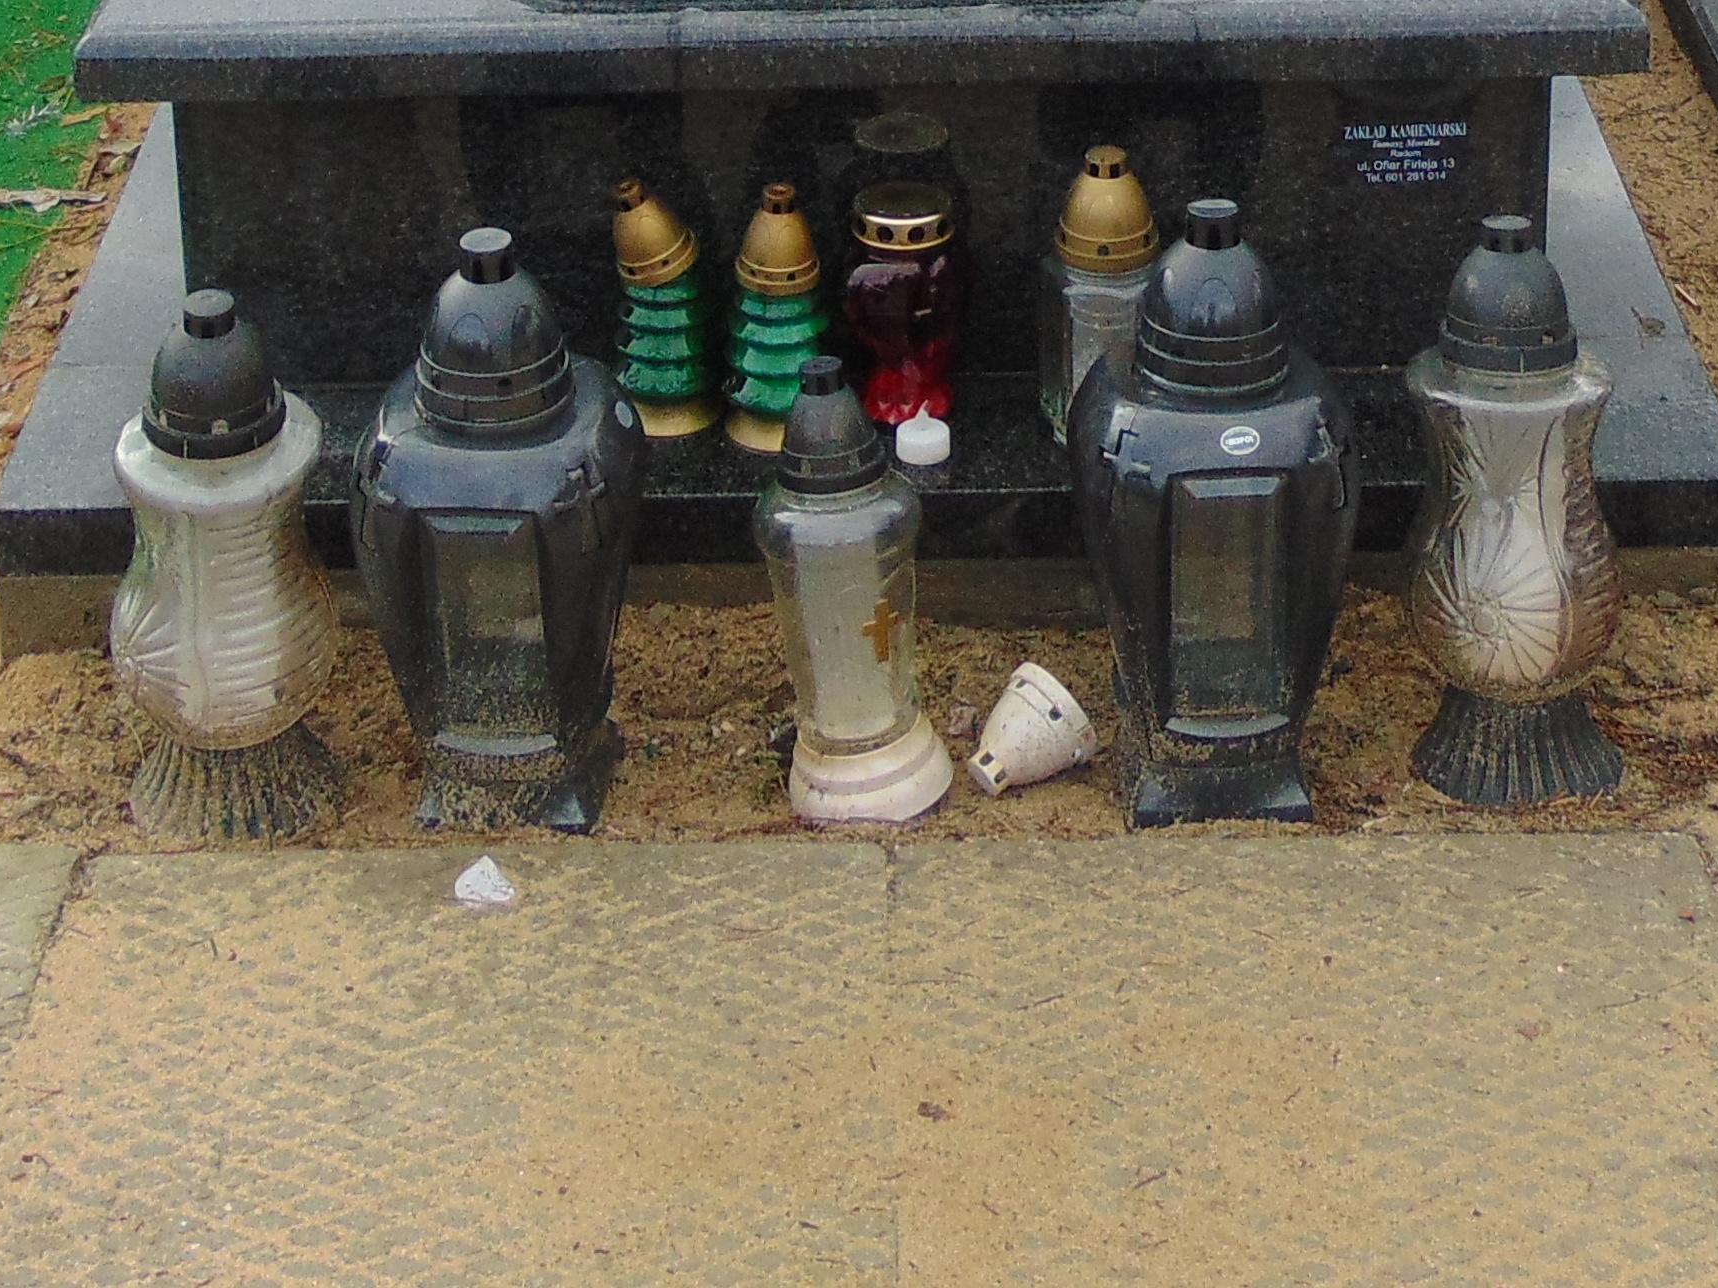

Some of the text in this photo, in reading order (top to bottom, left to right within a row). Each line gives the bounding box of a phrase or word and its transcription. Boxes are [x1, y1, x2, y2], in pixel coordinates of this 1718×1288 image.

[1390, 122, 1468, 138] KAMIENIARSKI
[1390, 149, 1422, 158] Radom
[1373, 159, 1402, 171] Ofiar
[1403, 158, 1438, 172] Firleja
[1442, 157, 1456, 169] 13
[1385, 172, 1403, 183] 601
[1427, 171, 1447, 181] 014
